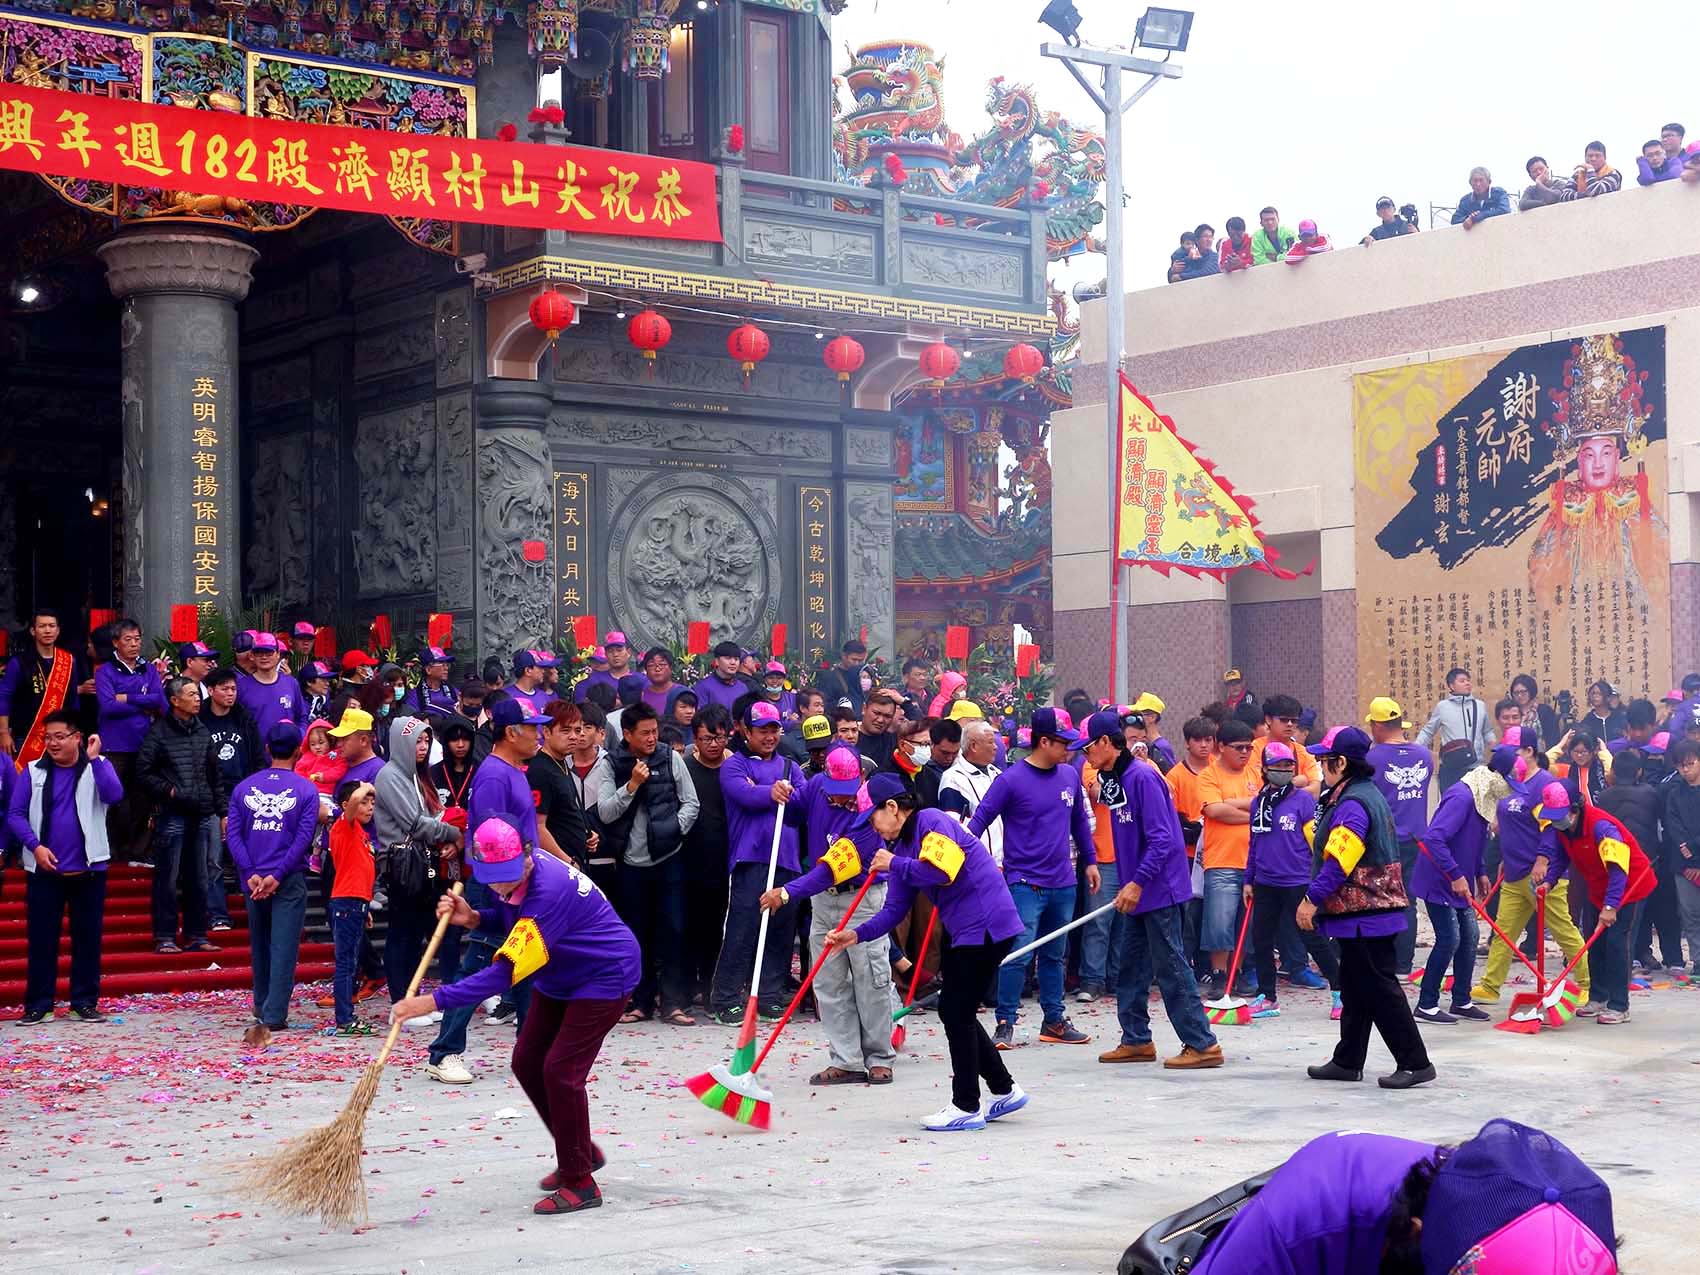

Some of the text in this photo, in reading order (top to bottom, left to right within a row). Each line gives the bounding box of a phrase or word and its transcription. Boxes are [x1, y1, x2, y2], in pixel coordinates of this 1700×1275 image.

[1127, 414, 1163, 433] 尖山
[1124, 437, 1147, 507] 顯濟殿
